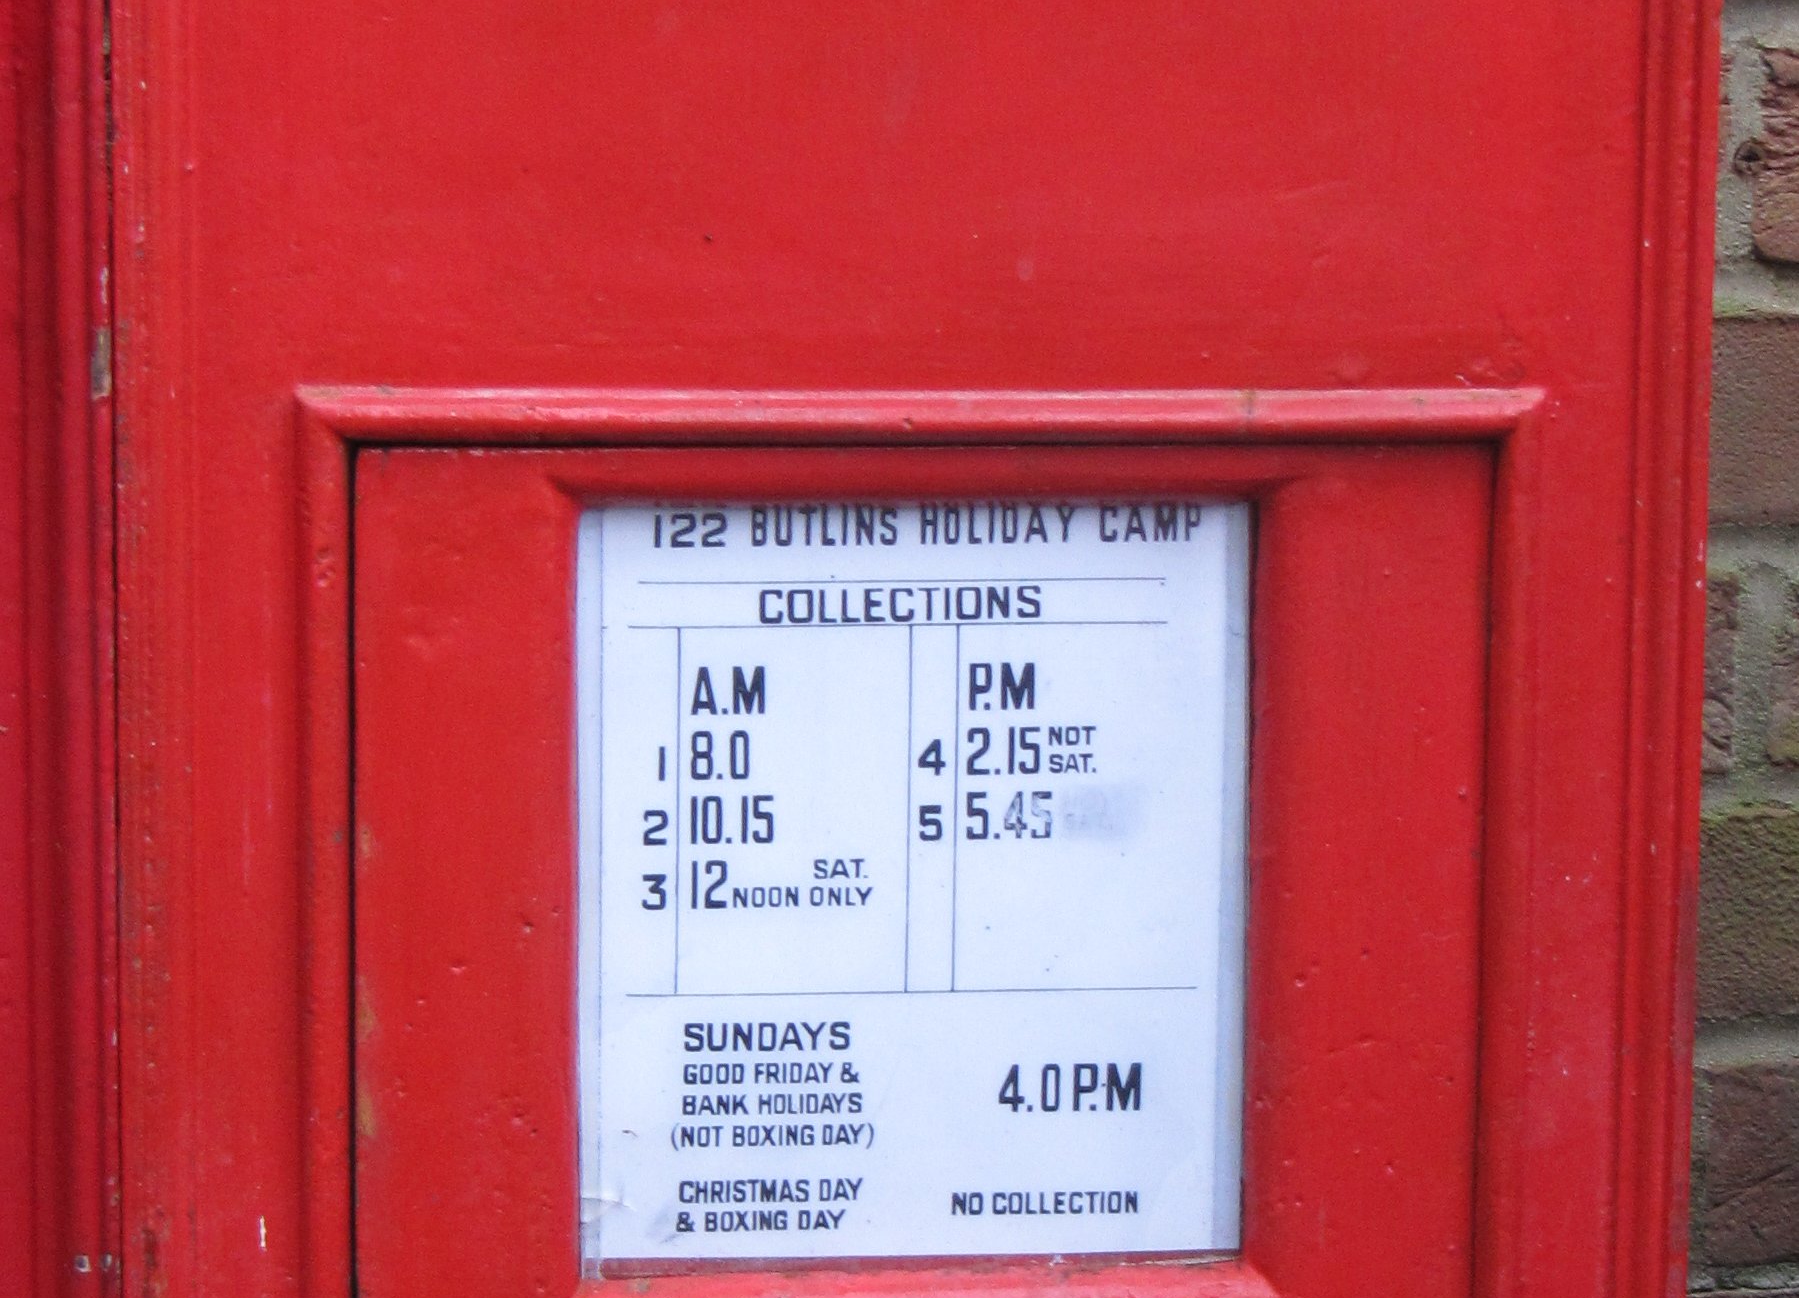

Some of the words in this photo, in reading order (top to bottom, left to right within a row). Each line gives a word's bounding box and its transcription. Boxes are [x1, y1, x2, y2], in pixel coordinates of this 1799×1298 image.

[653, 511, 727, 548] 122
[750, 506, 898, 546] BUTLINS
[919, 504, 1073, 544] HOLIDAY
[1099, 503, 1200, 543] CAMP
[760, 586, 1040, 623] COLLECTIONS
[691, 666, 765, 715] A.M
[1049, 726, 1096, 745] NOT
[659, 747, 665, 781] 1
[691, 730, 749, 780] 8.0
[918, 739, 945, 775] 4
[967, 727, 1040, 775] 2.15
[1050, 754, 1096, 773] SAT.
[644, 810, 668, 845] 2
[691, 795, 773, 844] 10.15
[920, 805, 942, 841] 5
[967, 792, 1053, 840] 5.45
[814, 859, 868, 879] SAT.
[642, 874, 666, 910] 3
[692, 860, 727, 909] 12
[733, 887, 798, 907] NOON
[810, 887, 872, 906] ONLY
[684, 1022, 850, 1052] SUNDAYS
[684, 1064, 744, 1084] GOOD
[755, 1063, 832, 1083] FRIDAY
[841, 1063, 859, 1083] &
[999, 1064, 1060, 1112] 4.0
[683, 1095, 748, 1115] BANK
[759, 1093, 862, 1114] HOLIDAYS
[671, 1126, 723, 1150] (NOT
[733, 1125, 814, 1147] BOXING
[823, 1124, 874, 1147] DAY)
[679, 1179, 809, 1203] CHRISTMAS
[820, 1178, 862, 1201] DAY
[952, 1193, 983, 1215] NO
[993, 1191, 1137, 1215] COLLECTION
[676, 1212, 694, 1232] &
[705, 1210, 787, 1232] BOXING
[798, 1210, 845, 1230] DAY
